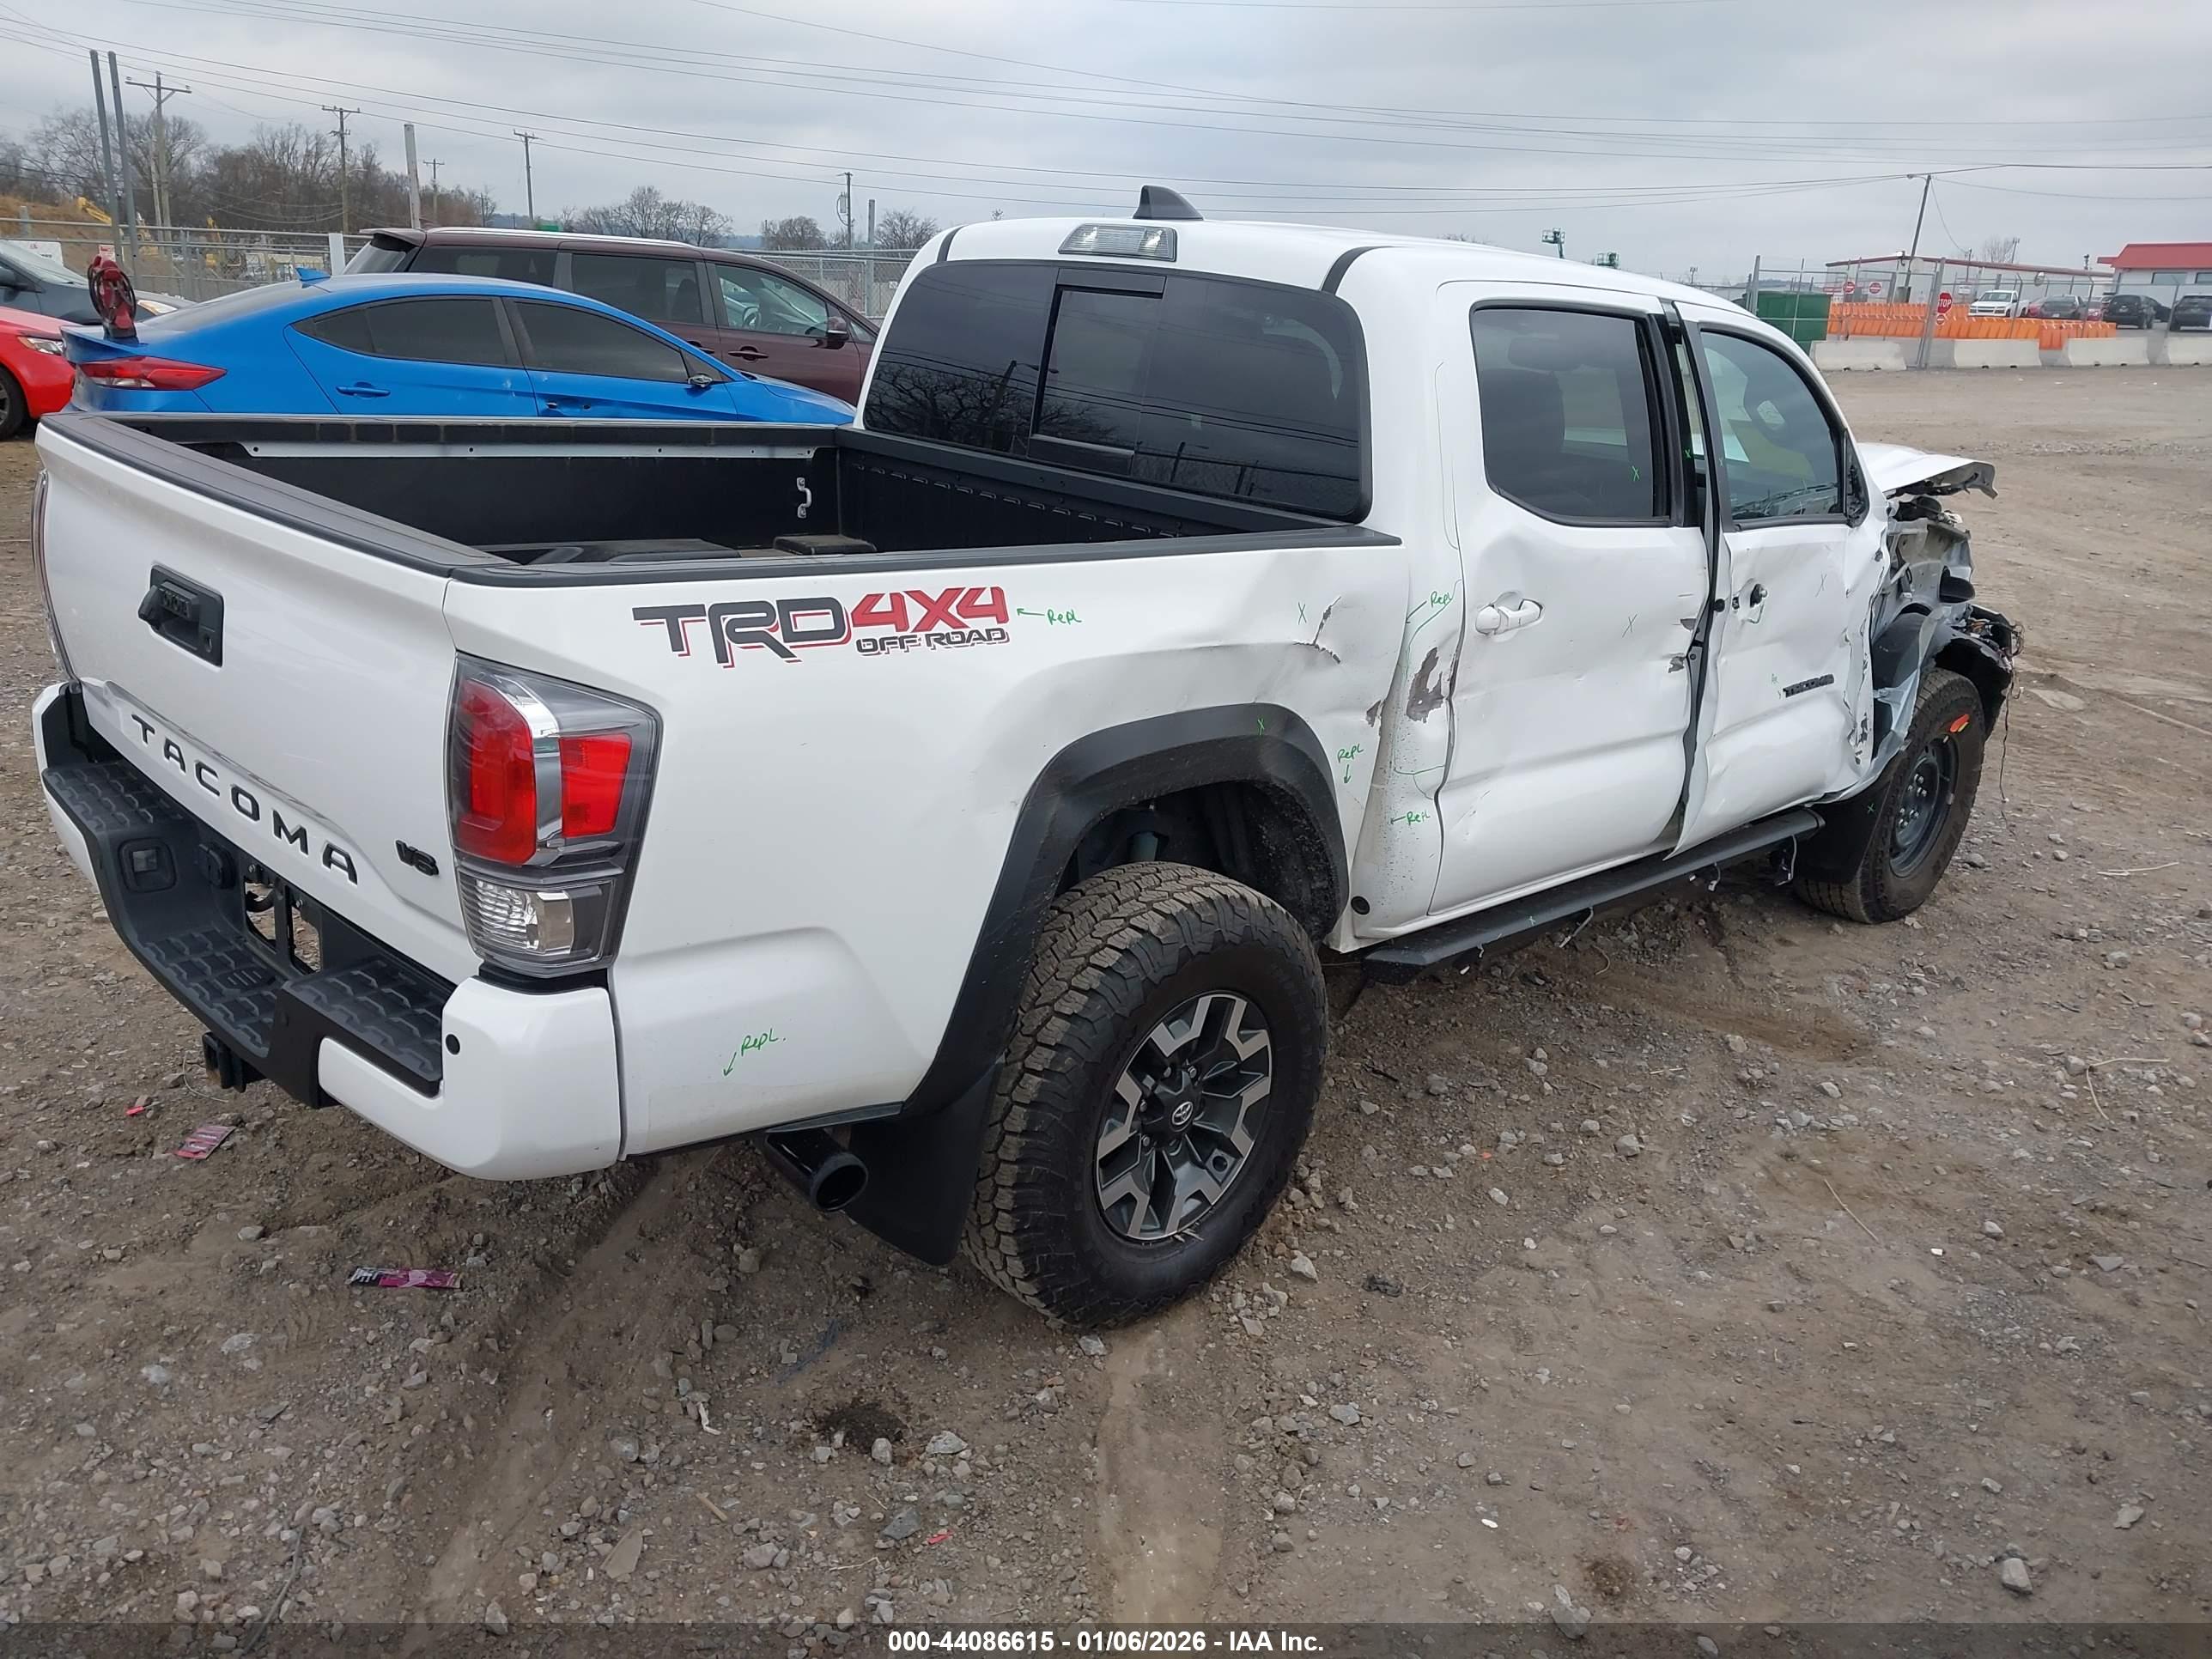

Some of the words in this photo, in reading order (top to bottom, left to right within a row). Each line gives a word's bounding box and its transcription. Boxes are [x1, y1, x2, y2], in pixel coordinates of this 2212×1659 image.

[1937, 297, 1953, 308] TOP
[632, 596, 852, 669] TRD
[852, 586, 1010, 632] 4X4
[855, 634, 922, 656] OFF
[926, 627, 1011, 650] ROAD
[131, 714, 358, 886] TACOMA
